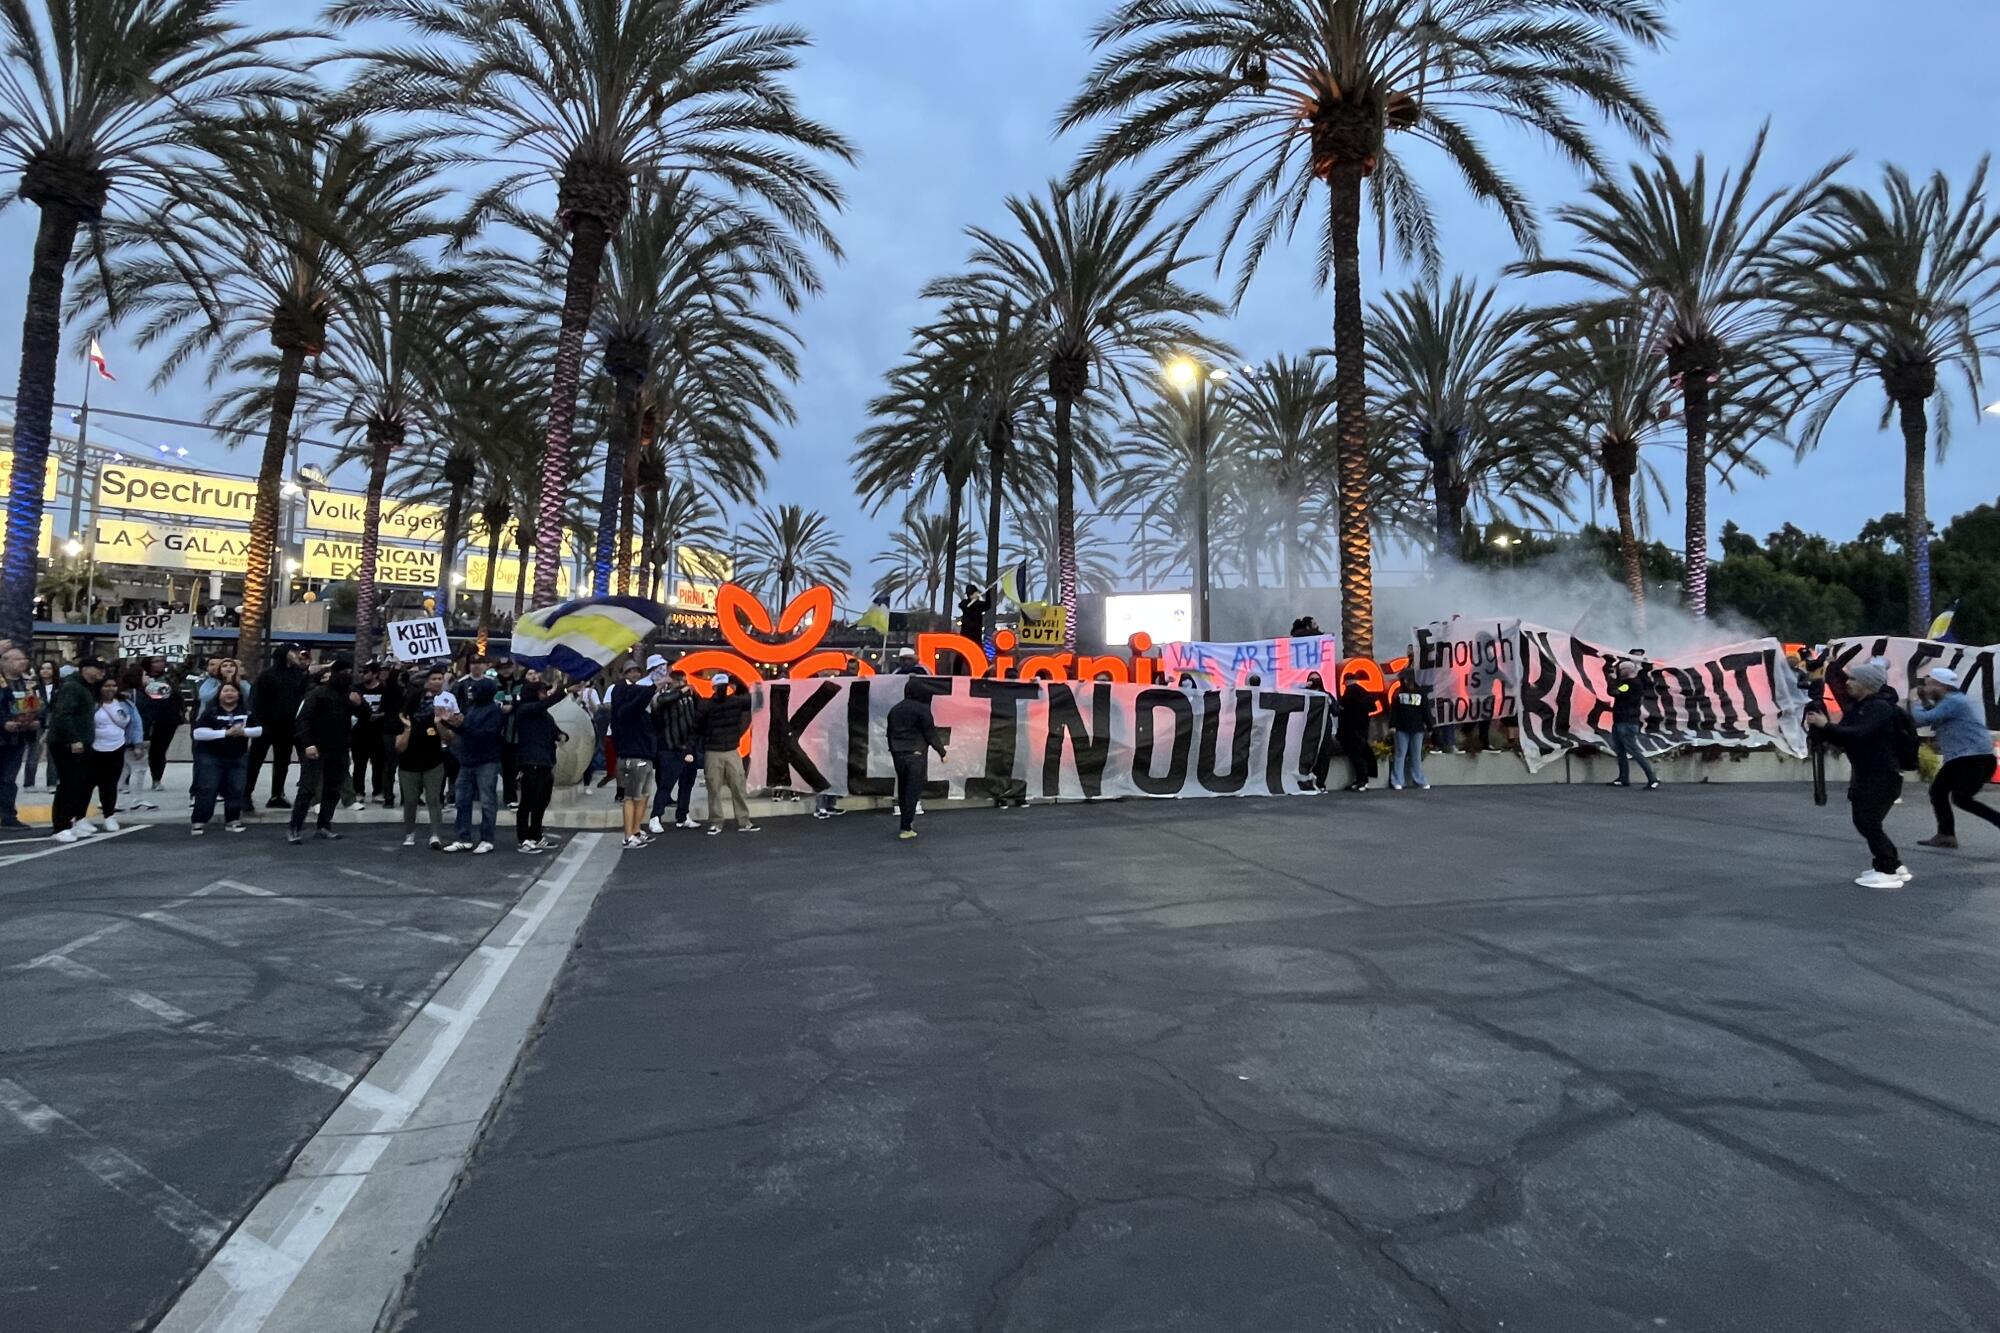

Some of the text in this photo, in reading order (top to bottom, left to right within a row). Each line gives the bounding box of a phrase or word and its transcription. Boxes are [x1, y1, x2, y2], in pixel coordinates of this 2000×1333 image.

[101, 470, 258, 509] Spectrum
[96, 528, 251, 556] LA GALAX
[312, 542, 434, 566] AMERICAN
[125, 614, 171, 631] STOP
[397, 622, 438, 641] KLEIN
[1022, 628, 1059, 641] OUT!
[121, 633, 168, 648] DECADE
[408, 637, 443, 655] OUT!
[1416, 623, 1514, 675] Enough
[1171, 639, 1334, 673] WE ARE THE
[1131, 688, 1328, 795] OUT!
